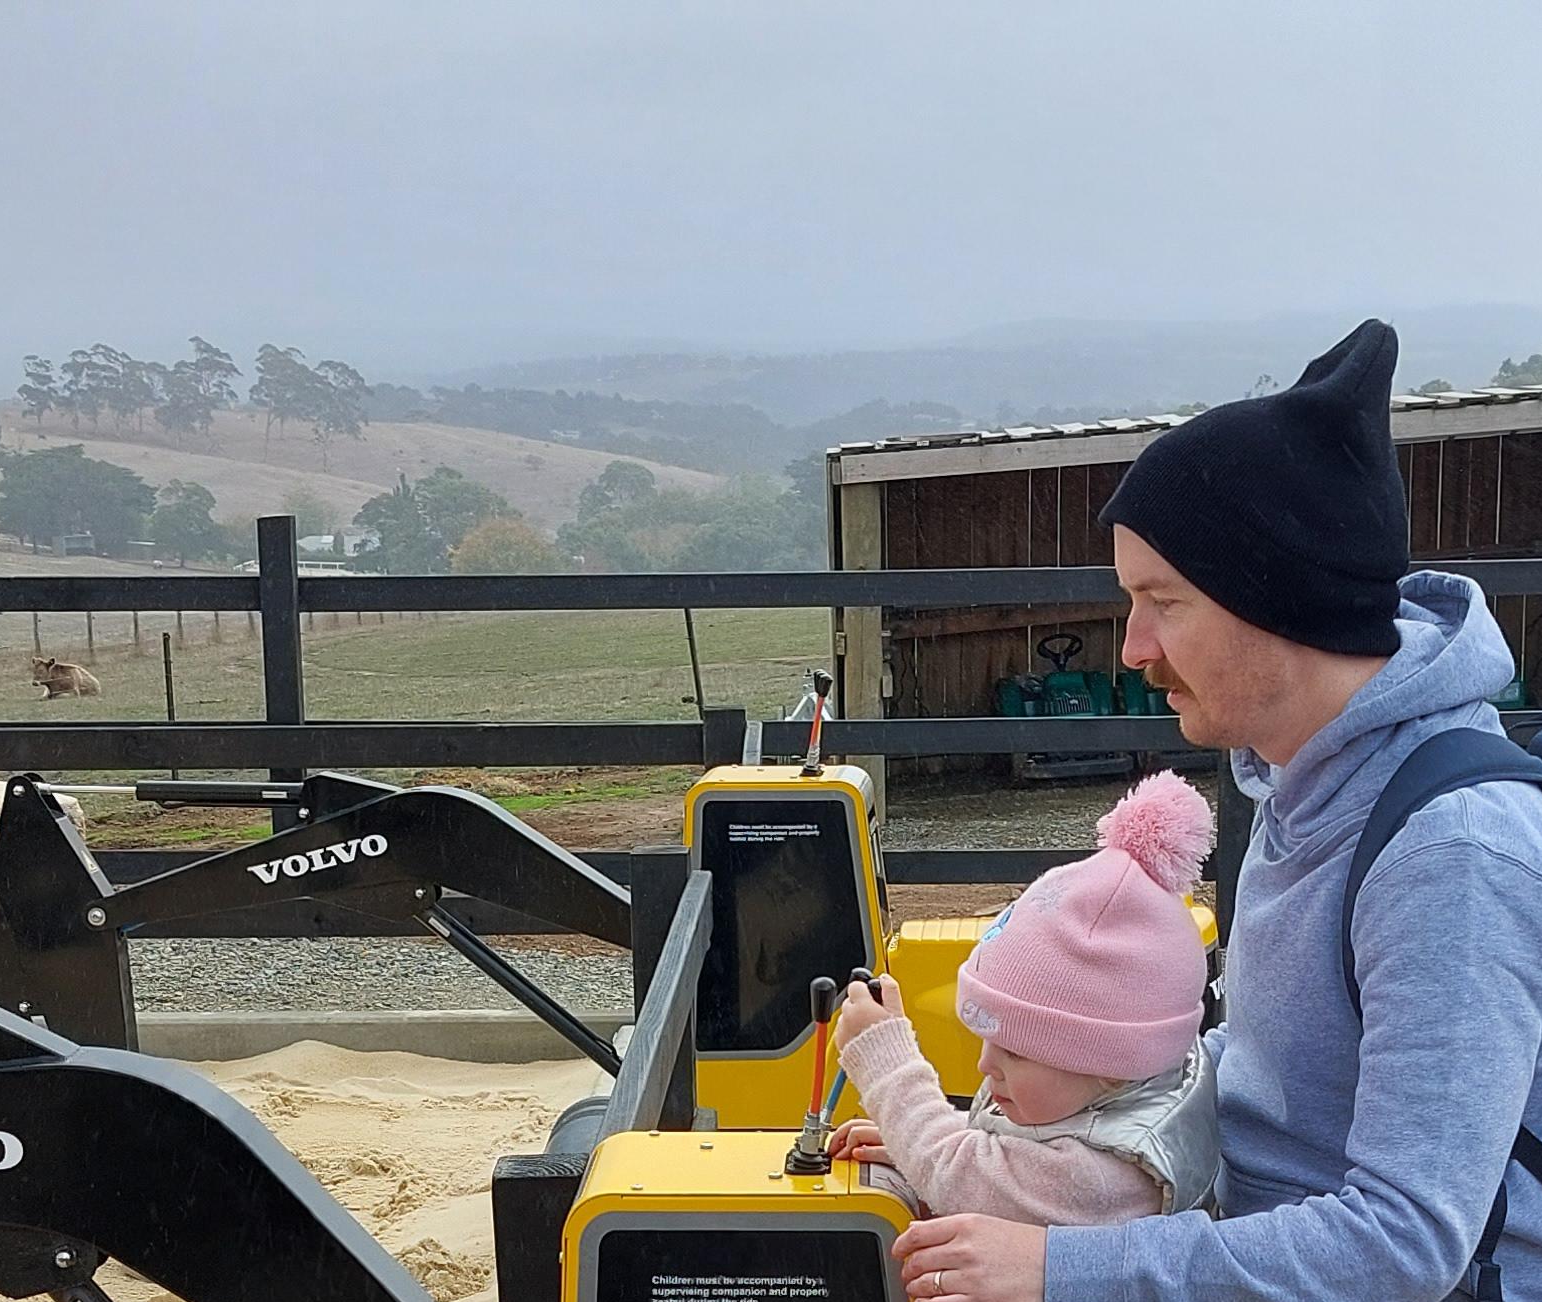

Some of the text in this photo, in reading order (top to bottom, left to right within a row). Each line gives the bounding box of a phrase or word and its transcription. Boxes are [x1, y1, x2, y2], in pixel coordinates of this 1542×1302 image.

[246, 834, 389, 884] VOLVO
[652, 1276, 694, 1286] Children
[696, 1276, 722, 1286] must
[737, 1276, 803, 1287] accompanied
[652, 1287, 710, 1298] supervising
[711, 1287, 767, 1298] companion
[768, 1287, 788, 1297] and
